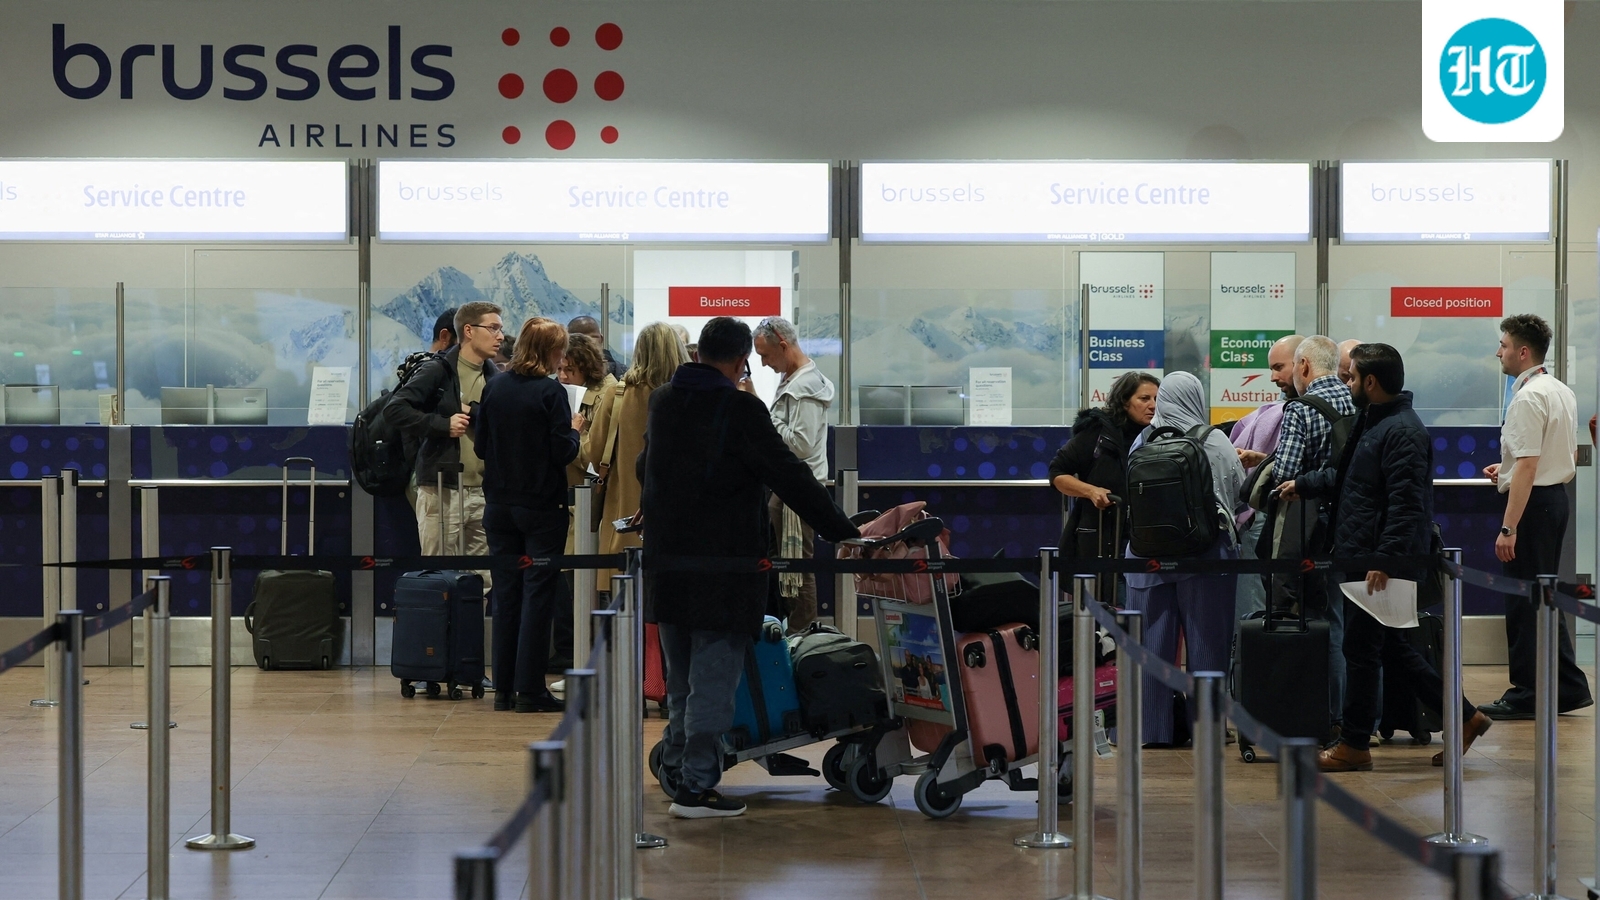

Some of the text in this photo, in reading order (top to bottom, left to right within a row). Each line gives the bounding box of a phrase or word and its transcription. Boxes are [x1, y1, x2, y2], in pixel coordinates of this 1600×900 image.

[52, 23, 456, 101] brussels
[258, 123, 456, 148] AIRLINES
[83, 184, 246, 208] Service Centre
[398, 181, 503, 201] brussels
[568, 185, 729, 208] Service Centre
[881, 183, 985, 202] brussels
[1050, 182, 1210, 205] Service Centre
[1371, 182, 1475, 202] brussels
[1090, 284, 1135, 294] brussels
[1220, 284, 1266, 294] brussels
[700, 296, 750, 307] Business
[1403, 297, 1491, 310] Closed position
[1089, 336, 1145, 348] Business
[1221, 337, 1275, 348] Econom
[1089, 350, 1123, 361] Class
[1220, 351, 1254, 362] Class
